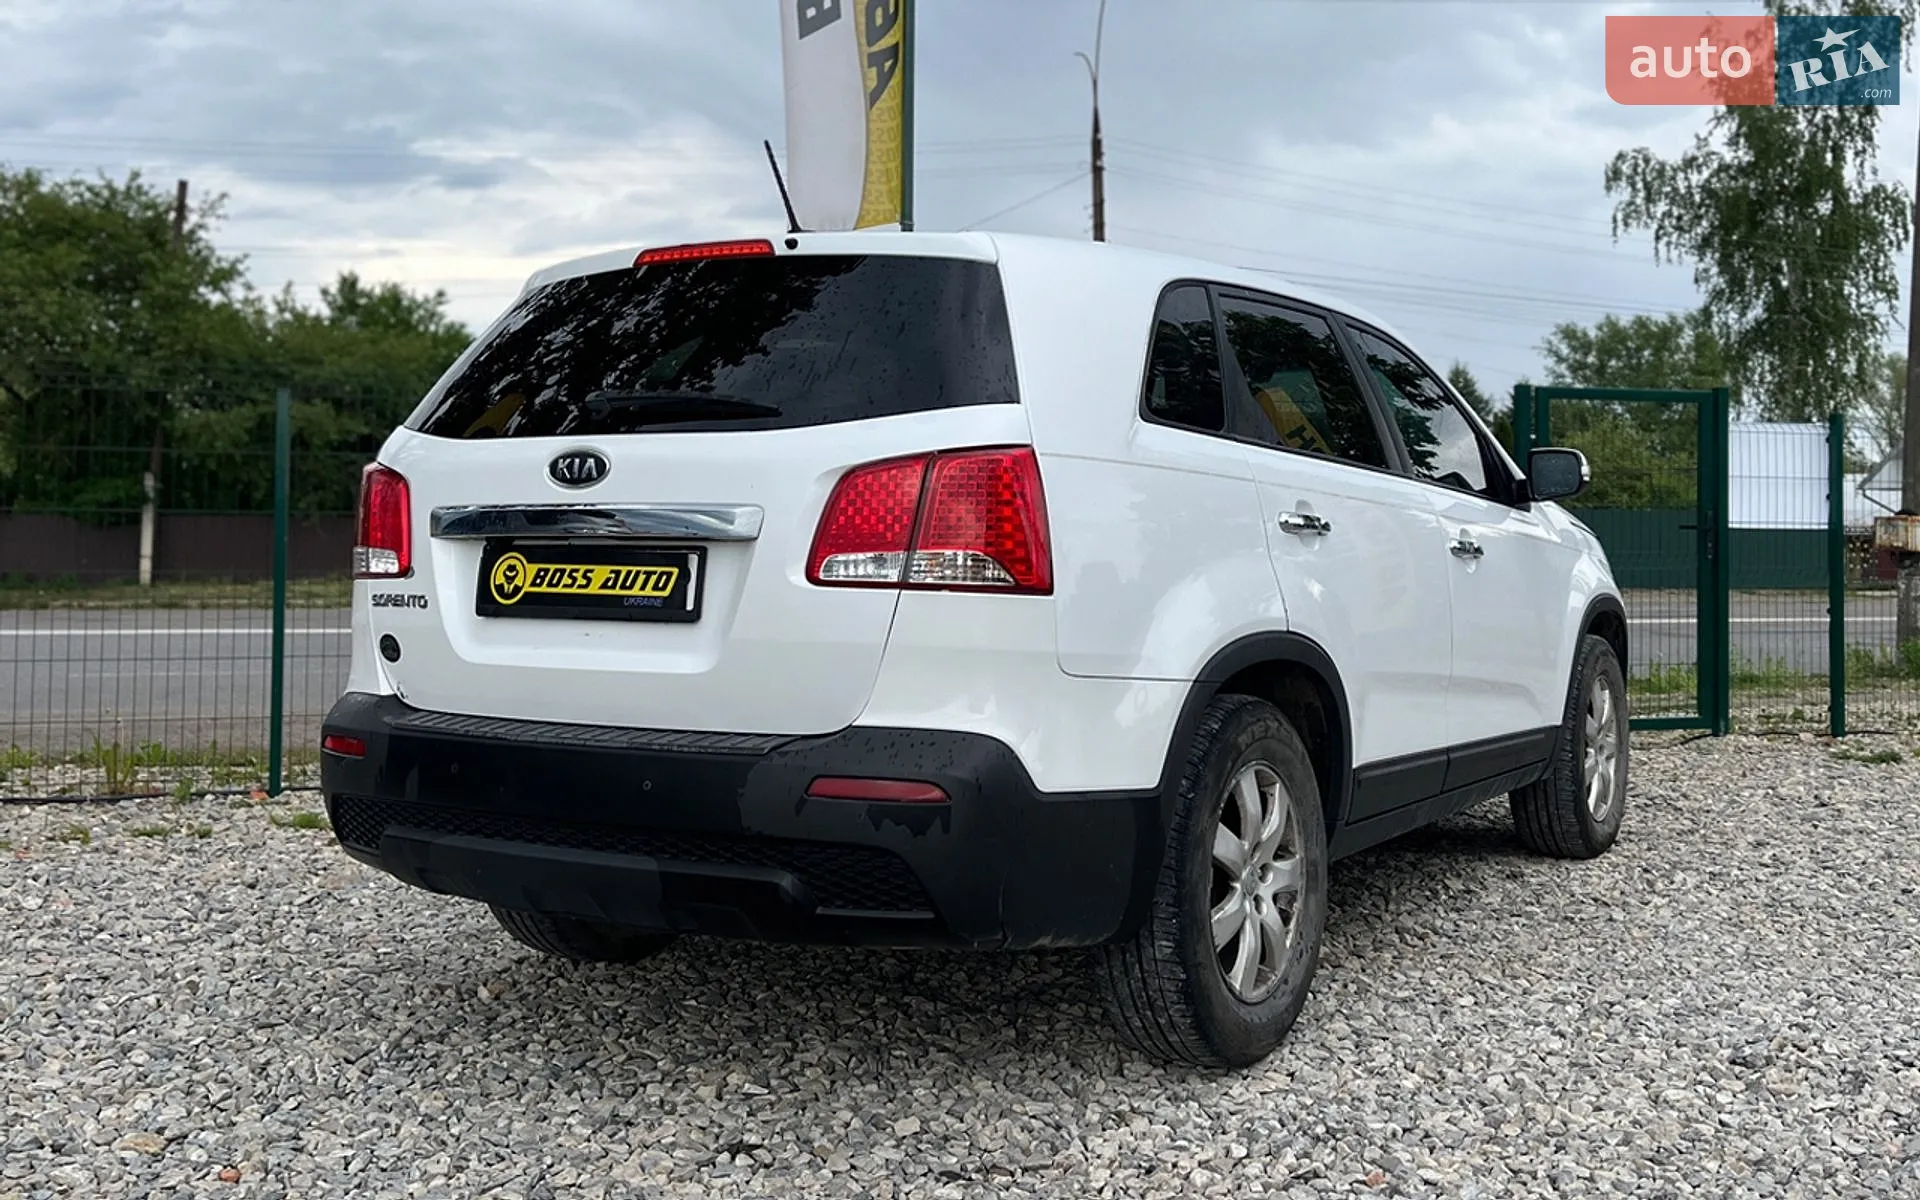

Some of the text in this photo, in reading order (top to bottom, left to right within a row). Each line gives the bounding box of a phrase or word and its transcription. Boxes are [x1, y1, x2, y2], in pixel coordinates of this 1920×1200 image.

[555, 456, 599, 480] KIA
[529, 566, 675, 593] BOSS AUTO
[371, 593, 429, 609] SORENTO
[623, 596, 665, 608] UKRAINE
